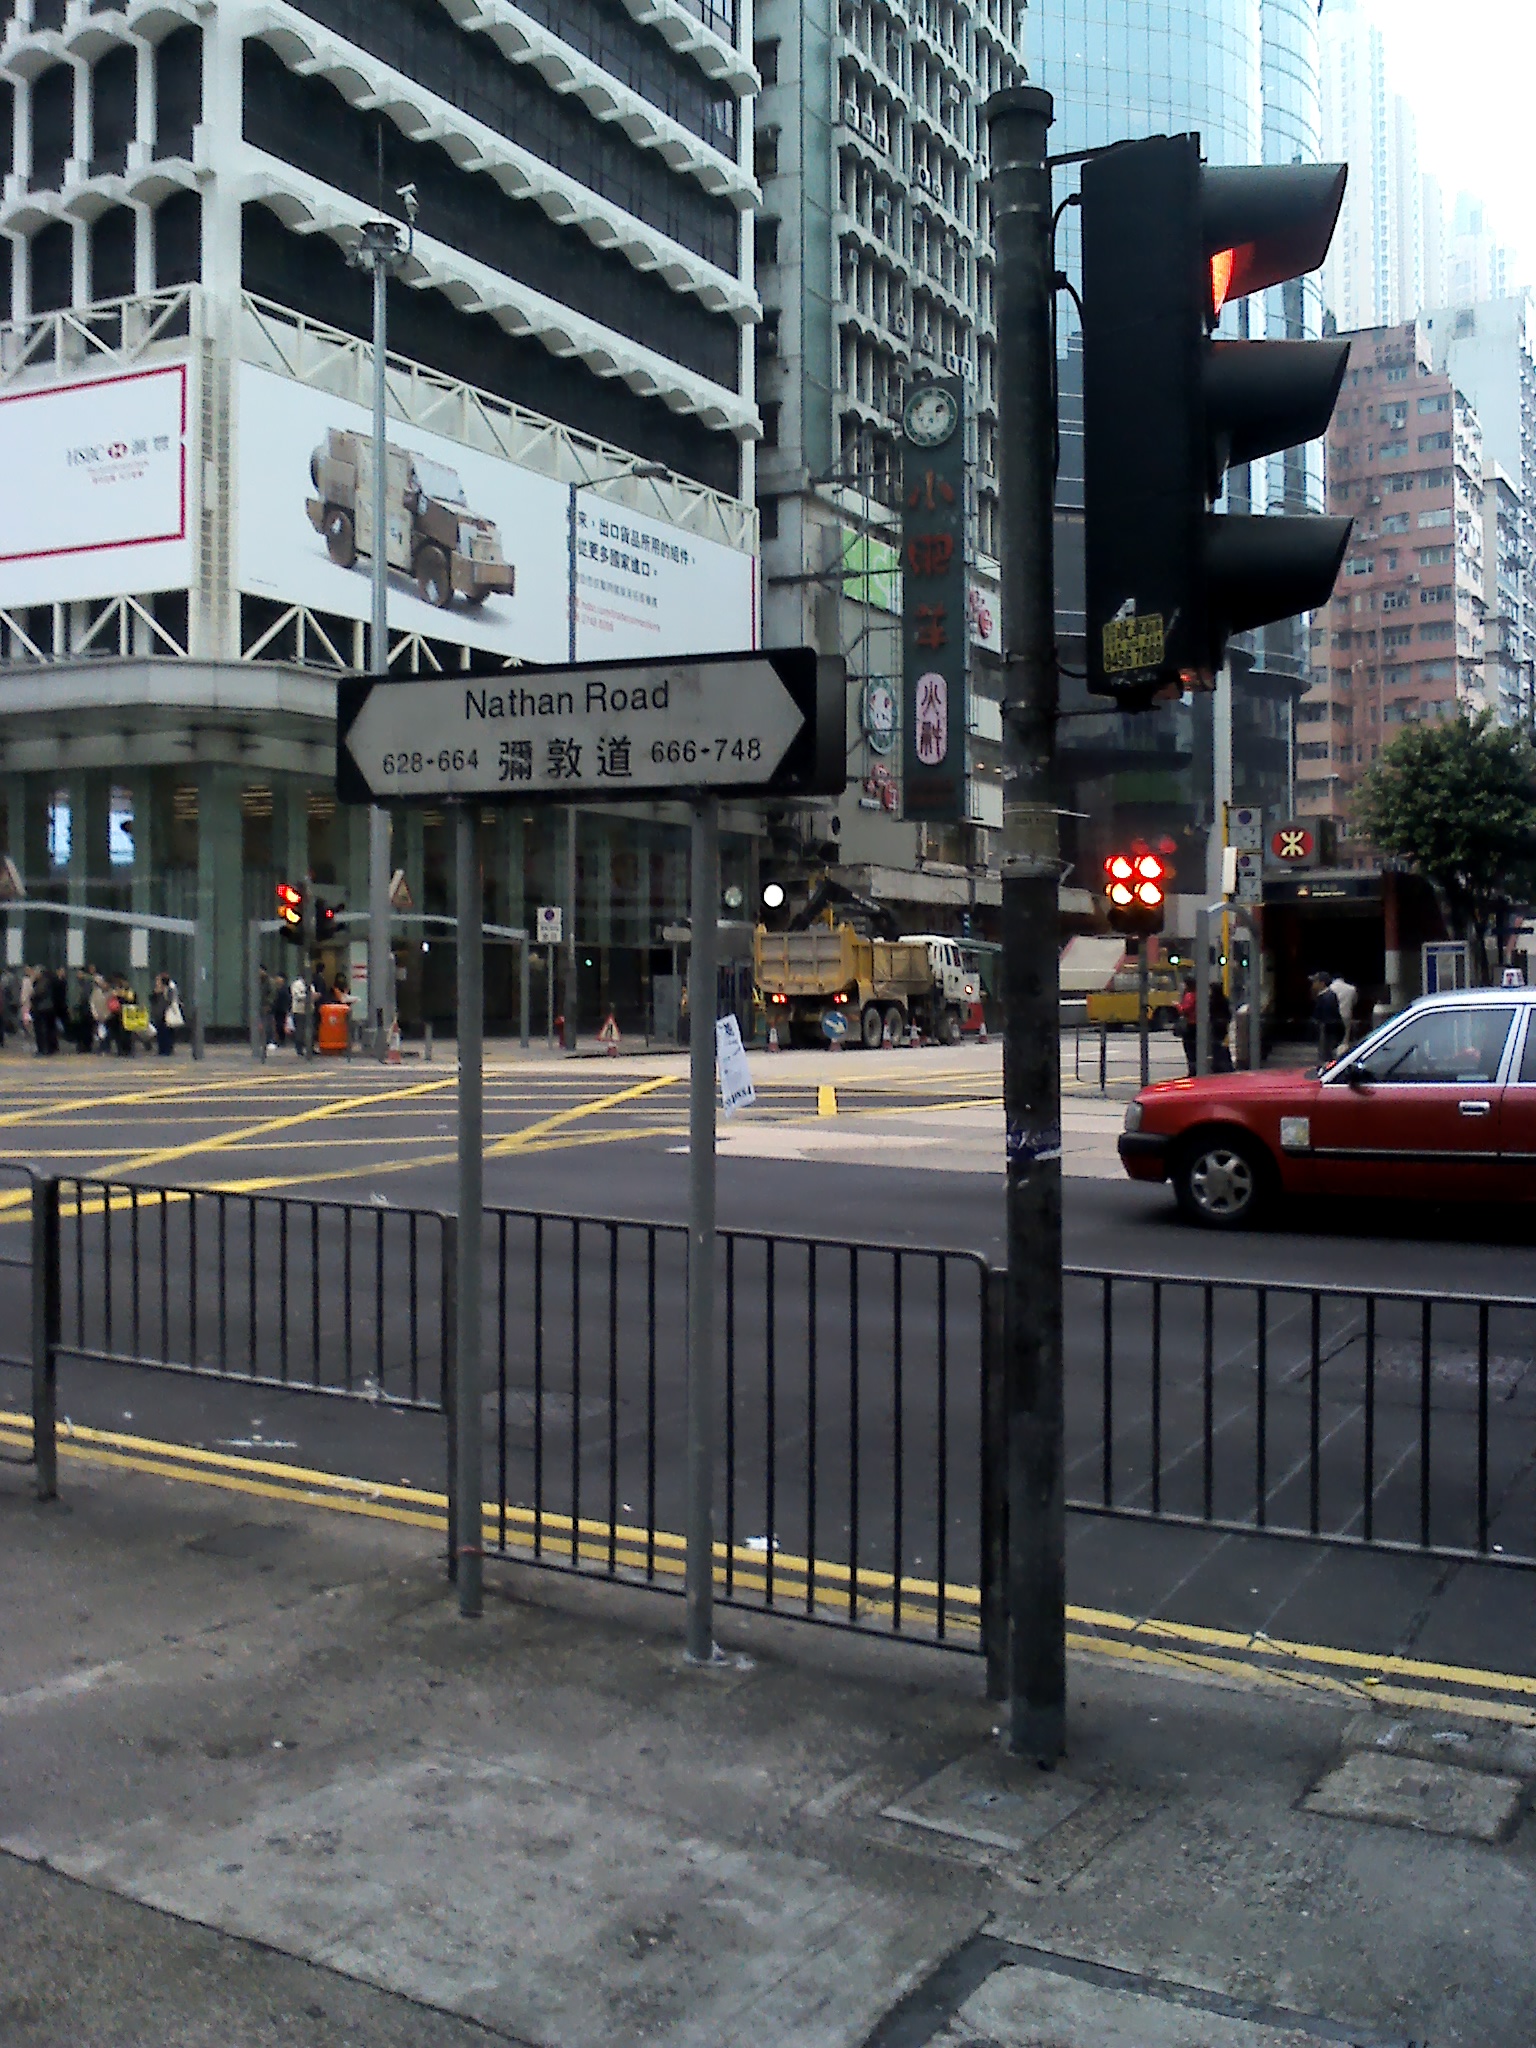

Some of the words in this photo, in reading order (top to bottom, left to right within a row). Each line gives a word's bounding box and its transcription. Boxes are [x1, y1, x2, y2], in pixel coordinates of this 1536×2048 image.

[567, 506, 696, 565] 來，出口貨品所用的組件，
[567, 536, 658, 577] 從更多國家進口。
[465, 688, 573, 720] Nathan
[586, 680, 669, 713] Road
[383, 749, 479, 775] 628-664
[499, 735, 632, 781] 彌敦道
[651, 737, 761, 763] 666-748
